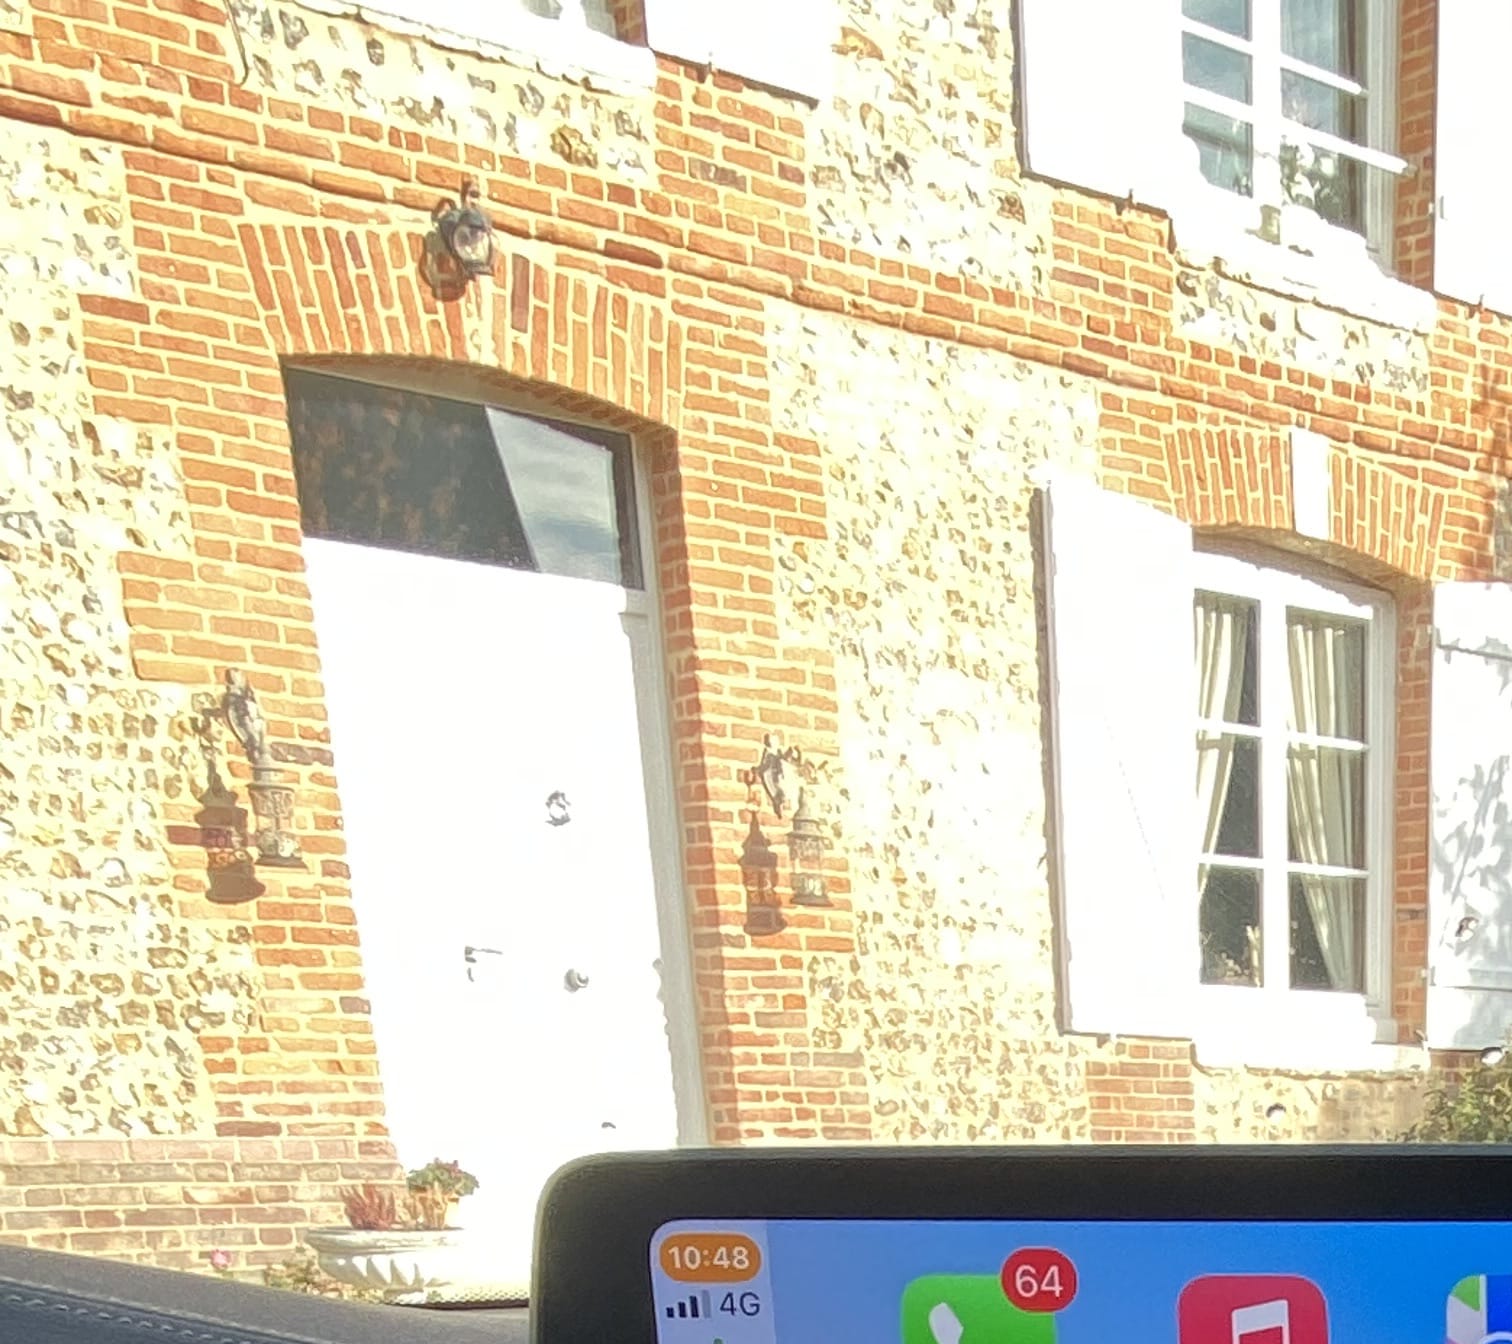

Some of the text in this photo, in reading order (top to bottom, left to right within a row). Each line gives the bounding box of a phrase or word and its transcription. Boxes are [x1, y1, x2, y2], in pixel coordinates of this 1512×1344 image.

[668, 1244, 750, 1272] 10:48
[1015, 1264, 1063, 1297] 64
[719, 1293, 761, 1318] 4G
